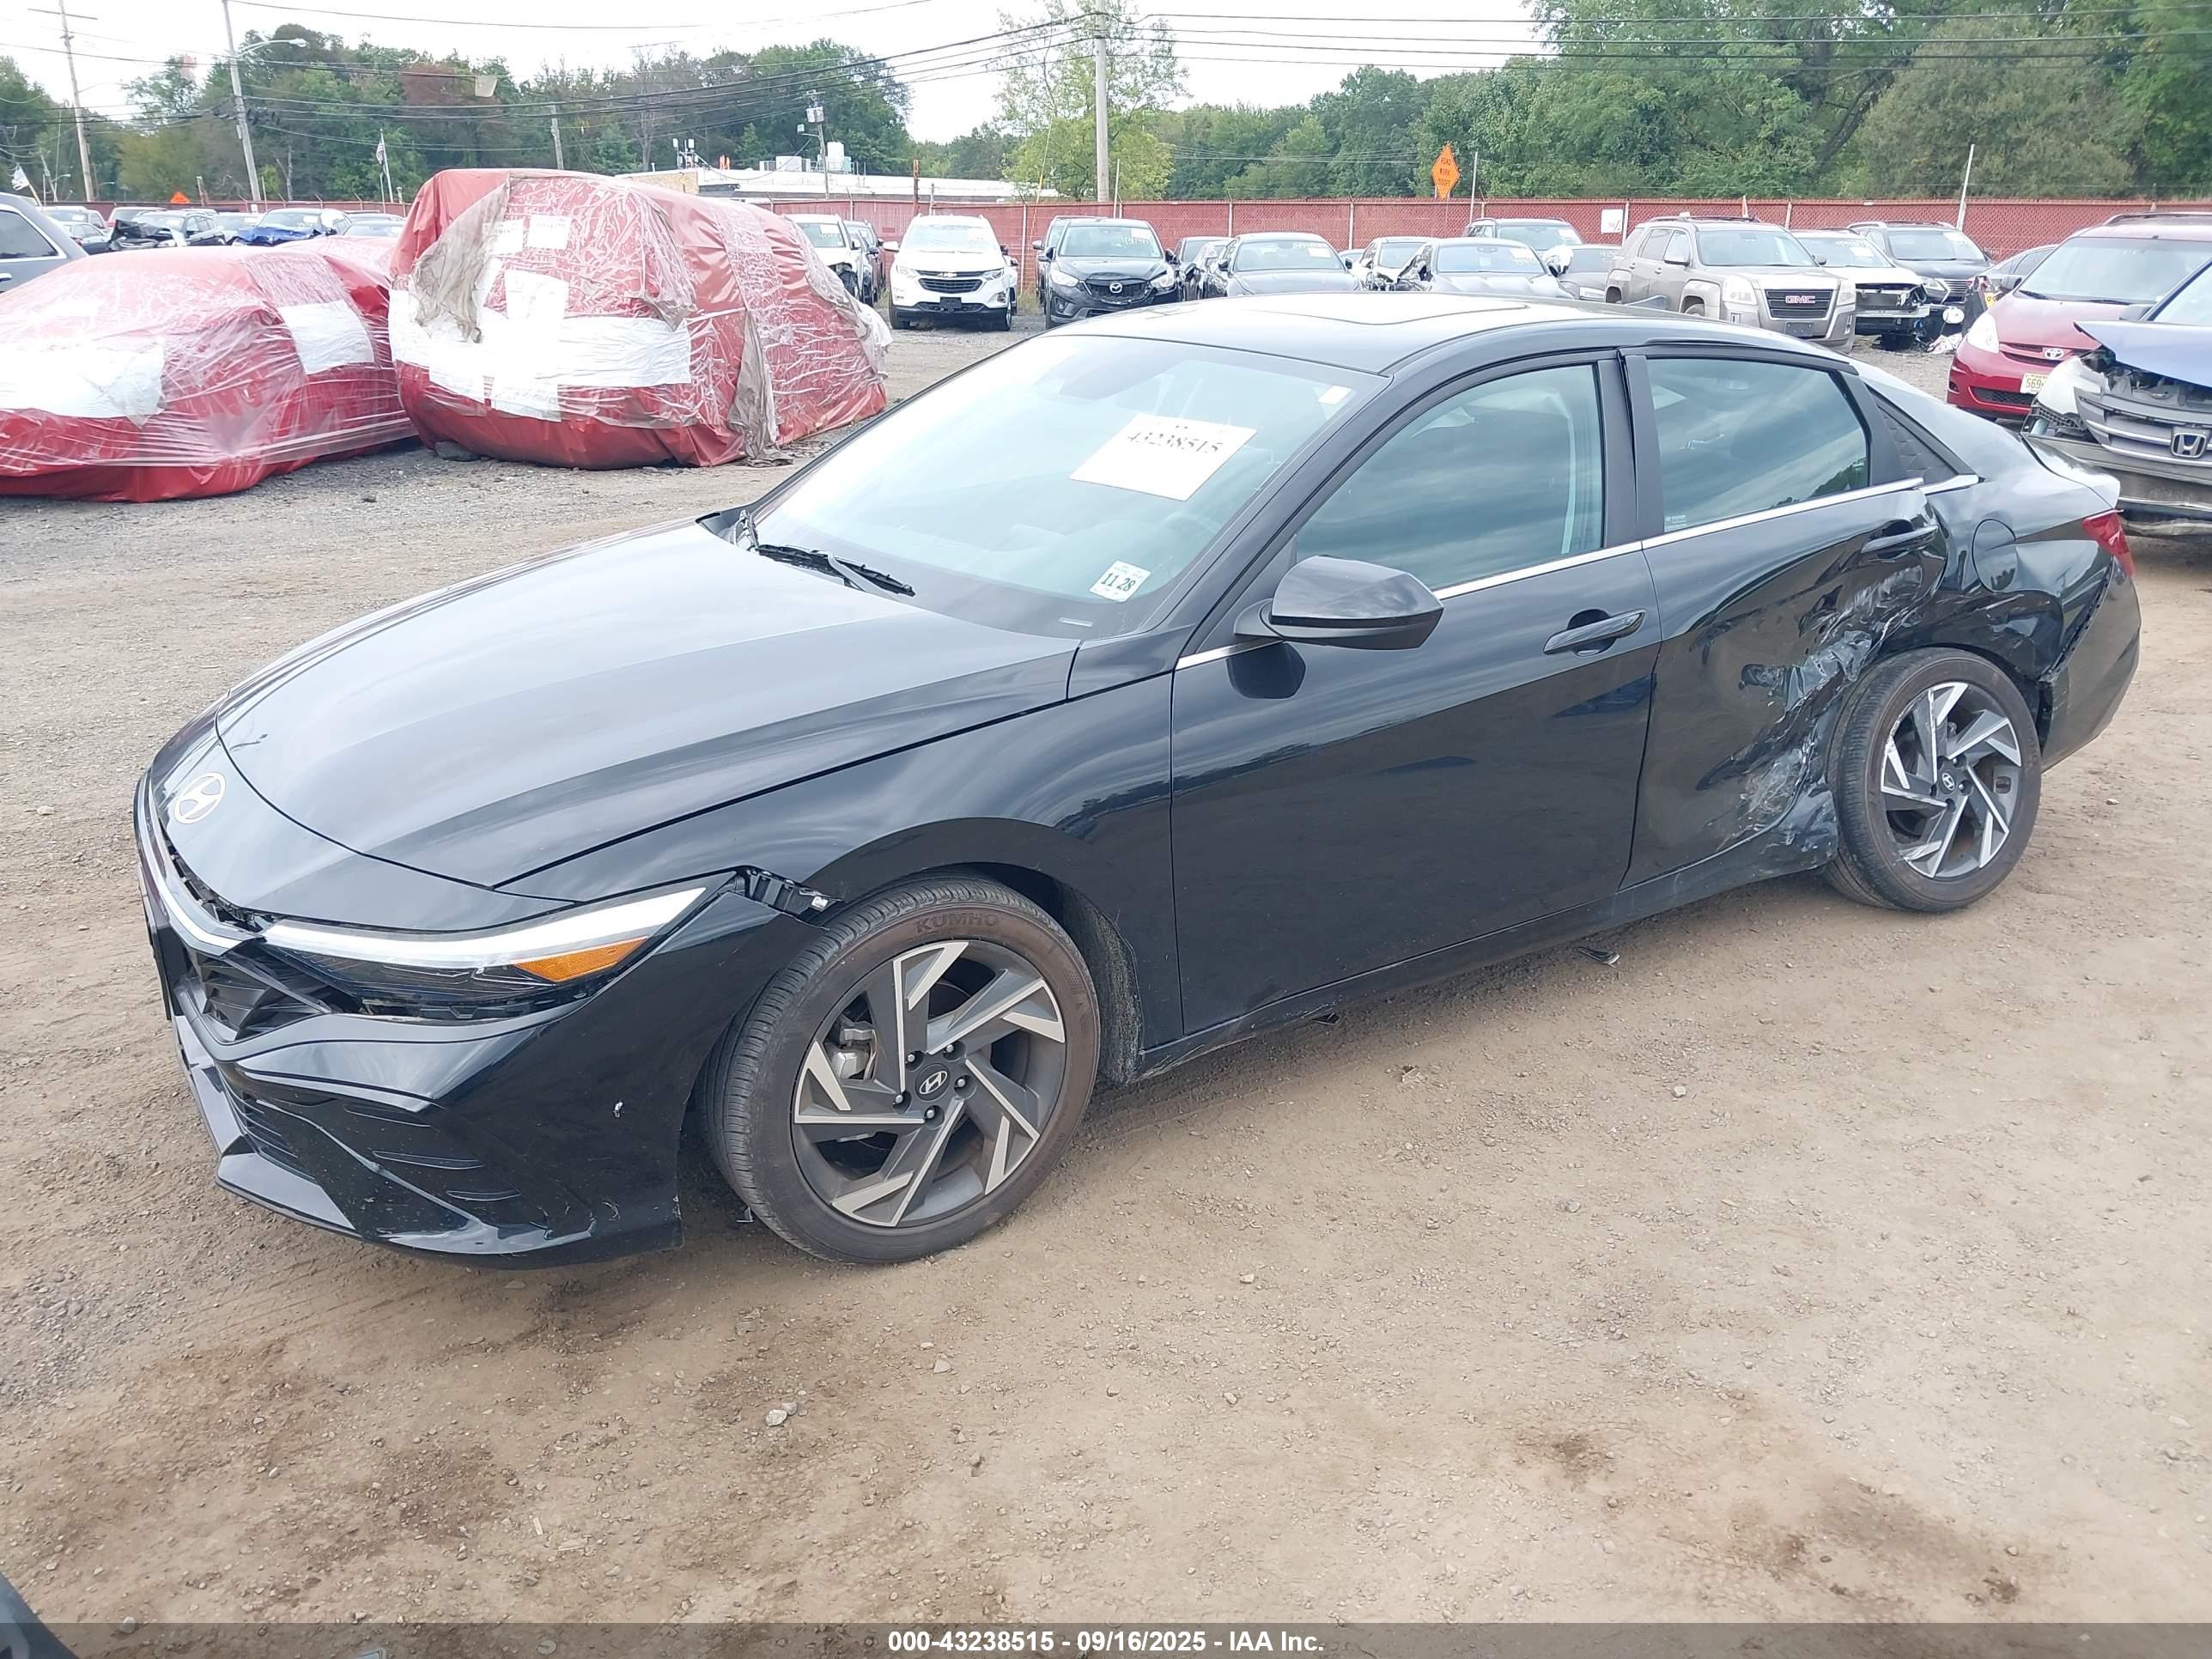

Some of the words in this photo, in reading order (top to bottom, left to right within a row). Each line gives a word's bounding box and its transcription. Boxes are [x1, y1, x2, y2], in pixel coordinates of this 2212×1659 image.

[1785, 295, 1816, 304] GMC
[1116, 577, 1136, 592] 28
[915, 912, 999, 933] KUMHO
